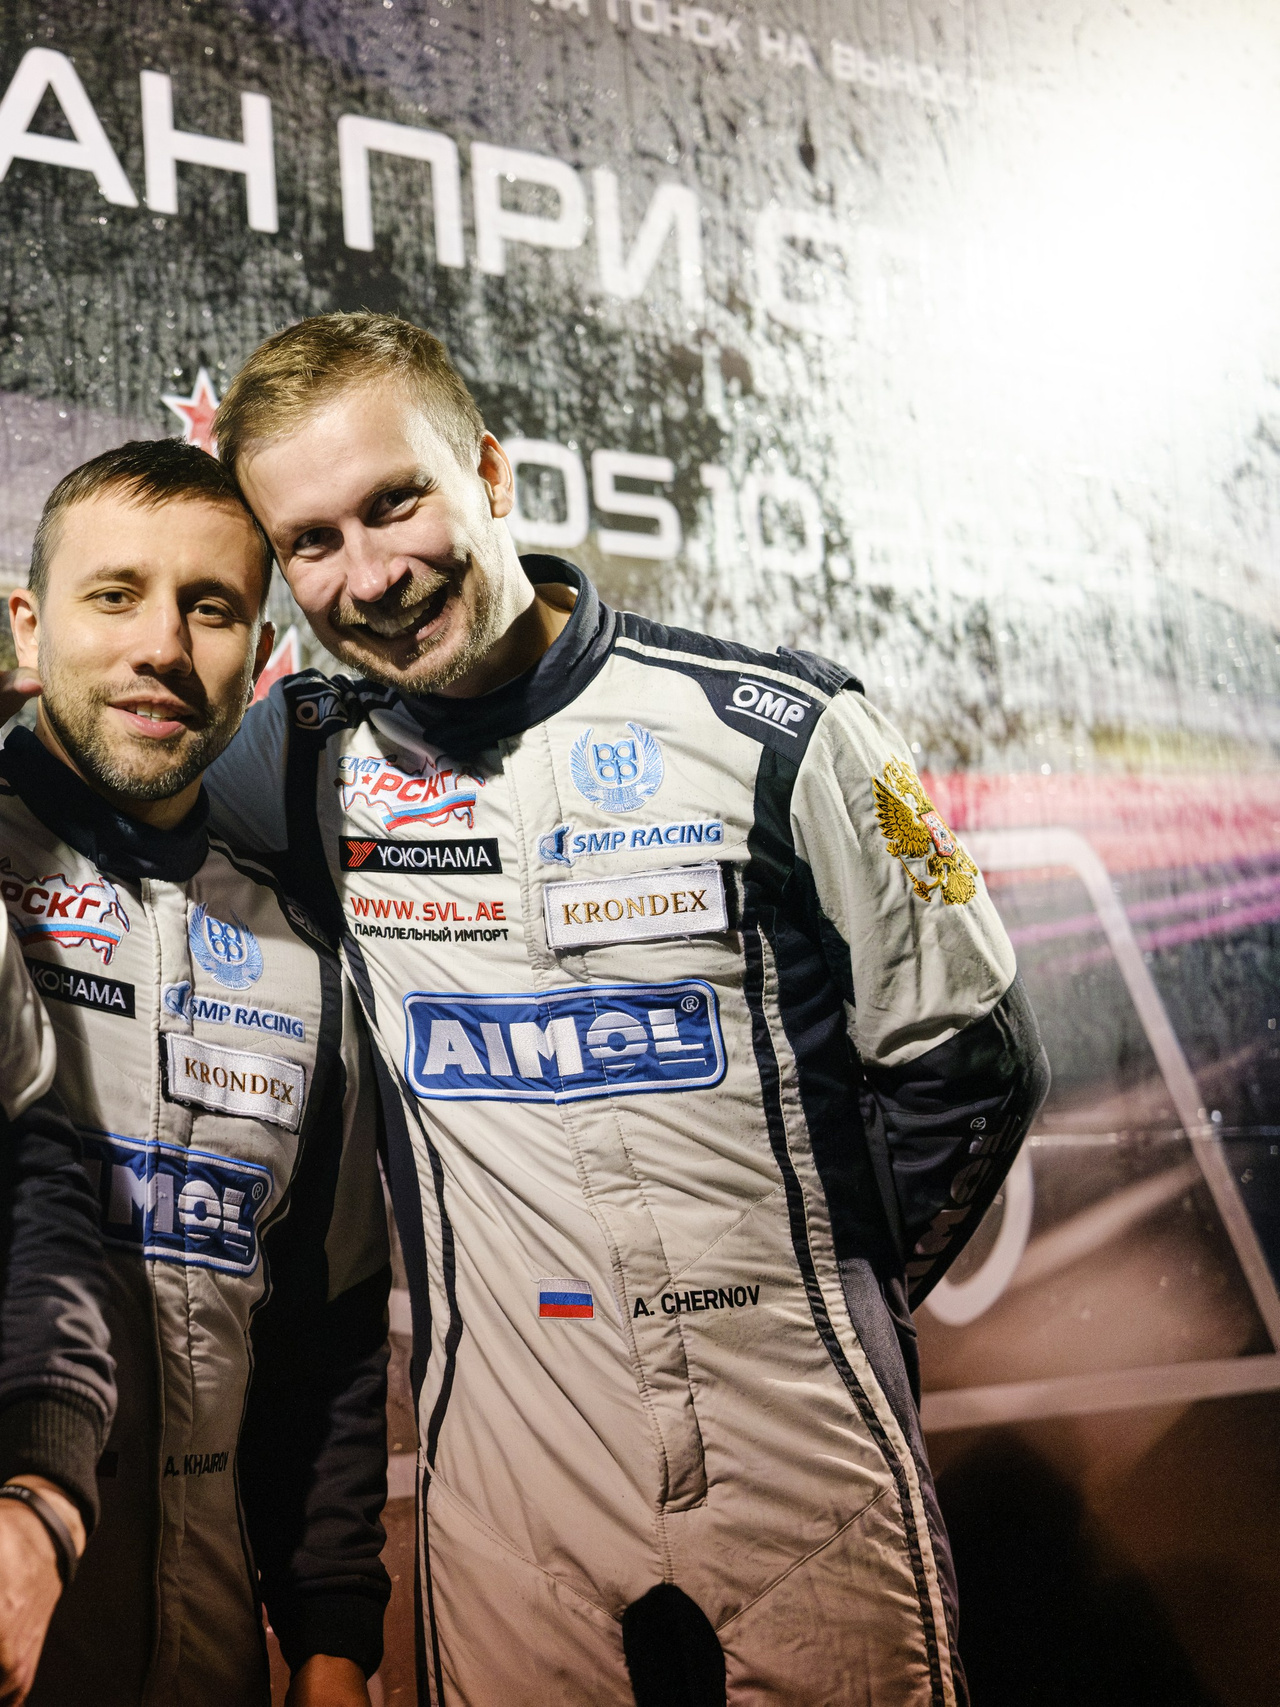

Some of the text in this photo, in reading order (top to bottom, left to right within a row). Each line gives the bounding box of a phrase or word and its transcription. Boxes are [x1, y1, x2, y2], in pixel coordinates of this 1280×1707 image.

[759, 26, 818, 69] НА
[337, 113, 706, 313] ПРИ
[732, 684, 805, 726] OMP
[338, 756, 380, 774] СМП
[370, 768, 454, 802] РСКГ
[377, 845, 493, 868] YOKOHAMA
[572, 823, 721, 854] SMP RACING
[0, 880, 101, 919] РСКГ
[350, 896, 507, 921] WWW.SVL.AE
[561, 889, 709, 926] KRONDEX
[354, 923, 509, 943] ПАРАЛЛЕЛЬНЫЙ ИМПОРТ
[31, 965, 127, 1010] KOHAMA
[189, 998, 304, 1038] SMP RACING
[422, 1009, 707, 1079] AIMOL
[184, 1056, 296, 1106] KRONDEX
[633, 1284, 760, 1319] A. CHERNOV
[163, 1455, 180, 1478] A.
